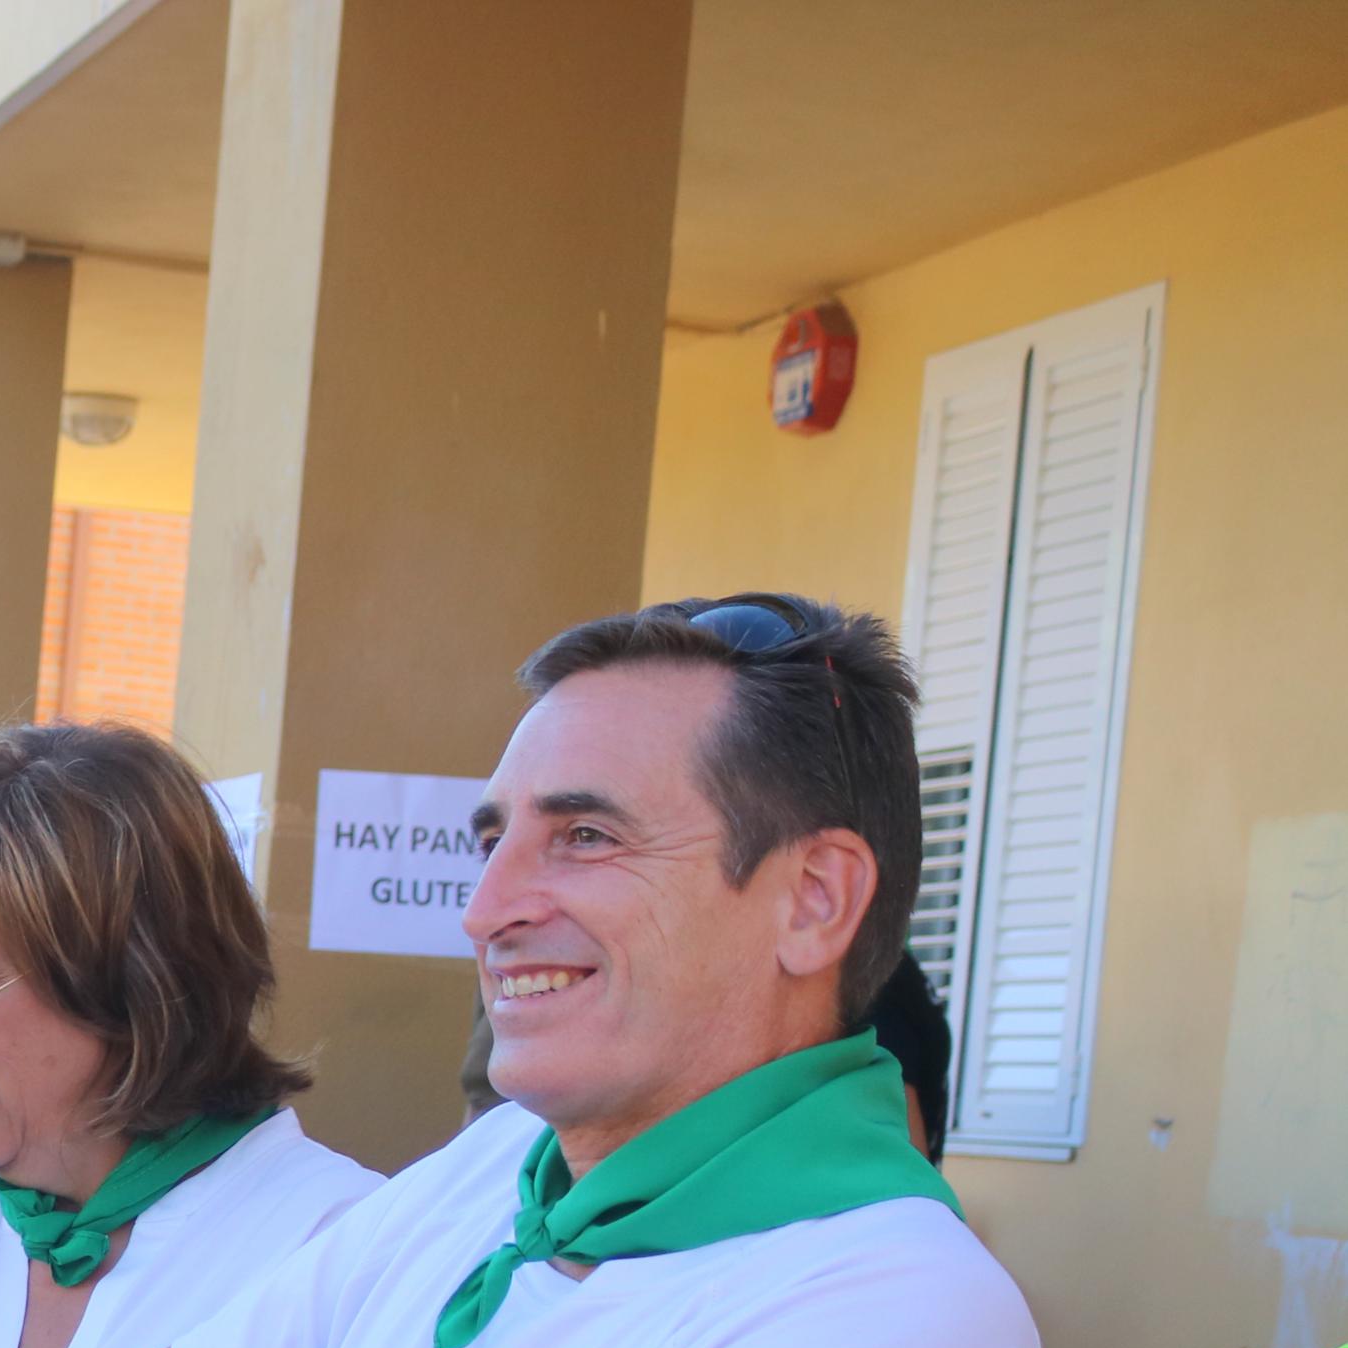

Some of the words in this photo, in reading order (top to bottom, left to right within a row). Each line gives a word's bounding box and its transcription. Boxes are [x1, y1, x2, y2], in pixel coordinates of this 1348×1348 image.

[334, 821, 401, 851] HAY
[411, 826, 476, 855] PAN
[370, 877, 473, 908] GLUTE
